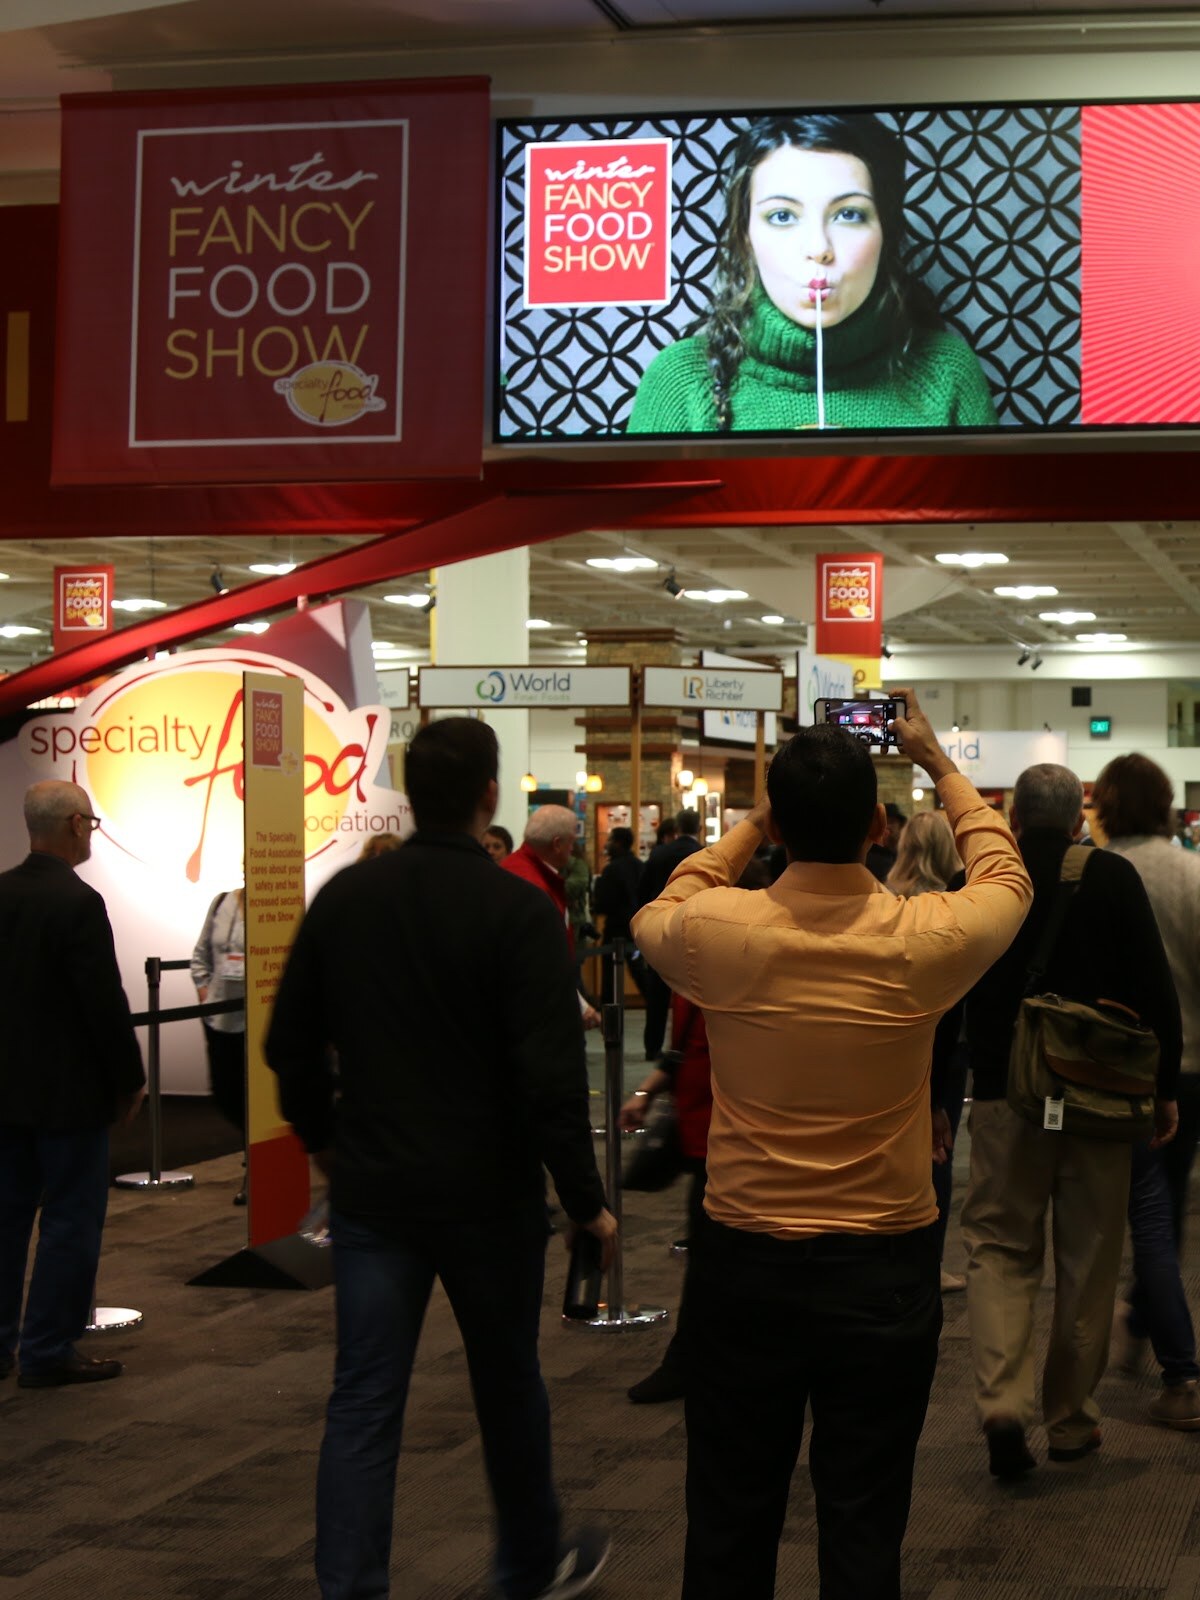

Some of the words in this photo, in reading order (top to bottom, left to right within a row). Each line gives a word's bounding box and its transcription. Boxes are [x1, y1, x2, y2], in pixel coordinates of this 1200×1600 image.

[171, 151, 379, 197] winter
[544, 156, 656, 181] winter
[544, 181, 654, 211] FANCY
[168, 200, 375, 257] FANCY
[544, 211, 653, 243] FOOD
[544, 243, 652, 272] SHOW
[168, 261, 371, 320] FOOD
[164, 324, 369, 380] SHOW
[320, 369, 376, 424] food
[829, 576, 869, 588] FANCY
[829, 587, 869, 599] FOOD
[66, 597, 102, 610] FOOD
[829, 599, 869, 610] SHOW
[510, 672, 571, 692] World
[706, 677, 744, 690] Liberty
[256, 708, 281, 723] FANCY
[30, 714, 212, 762] specialty
[256, 722, 280, 739] FOOD
[256, 738, 280, 752] SHOW
[303, 810, 400, 833] ociation
[256, 832, 268, 842] The
[269, 831, 297, 845] Specialty
[250, 848, 266, 858] Food
[268, 847, 302, 859] Association
[251, 866, 268, 875] cares
[269, 864, 287, 875] about
[288, 865, 303, 876] your
[255, 881, 273, 893] safety
[275, 880, 287, 891] and
[288, 880, 299, 890] has
[258, 913, 264, 923] at
[266, 912, 277, 923] the
[251, 946, 270, 957] Please
